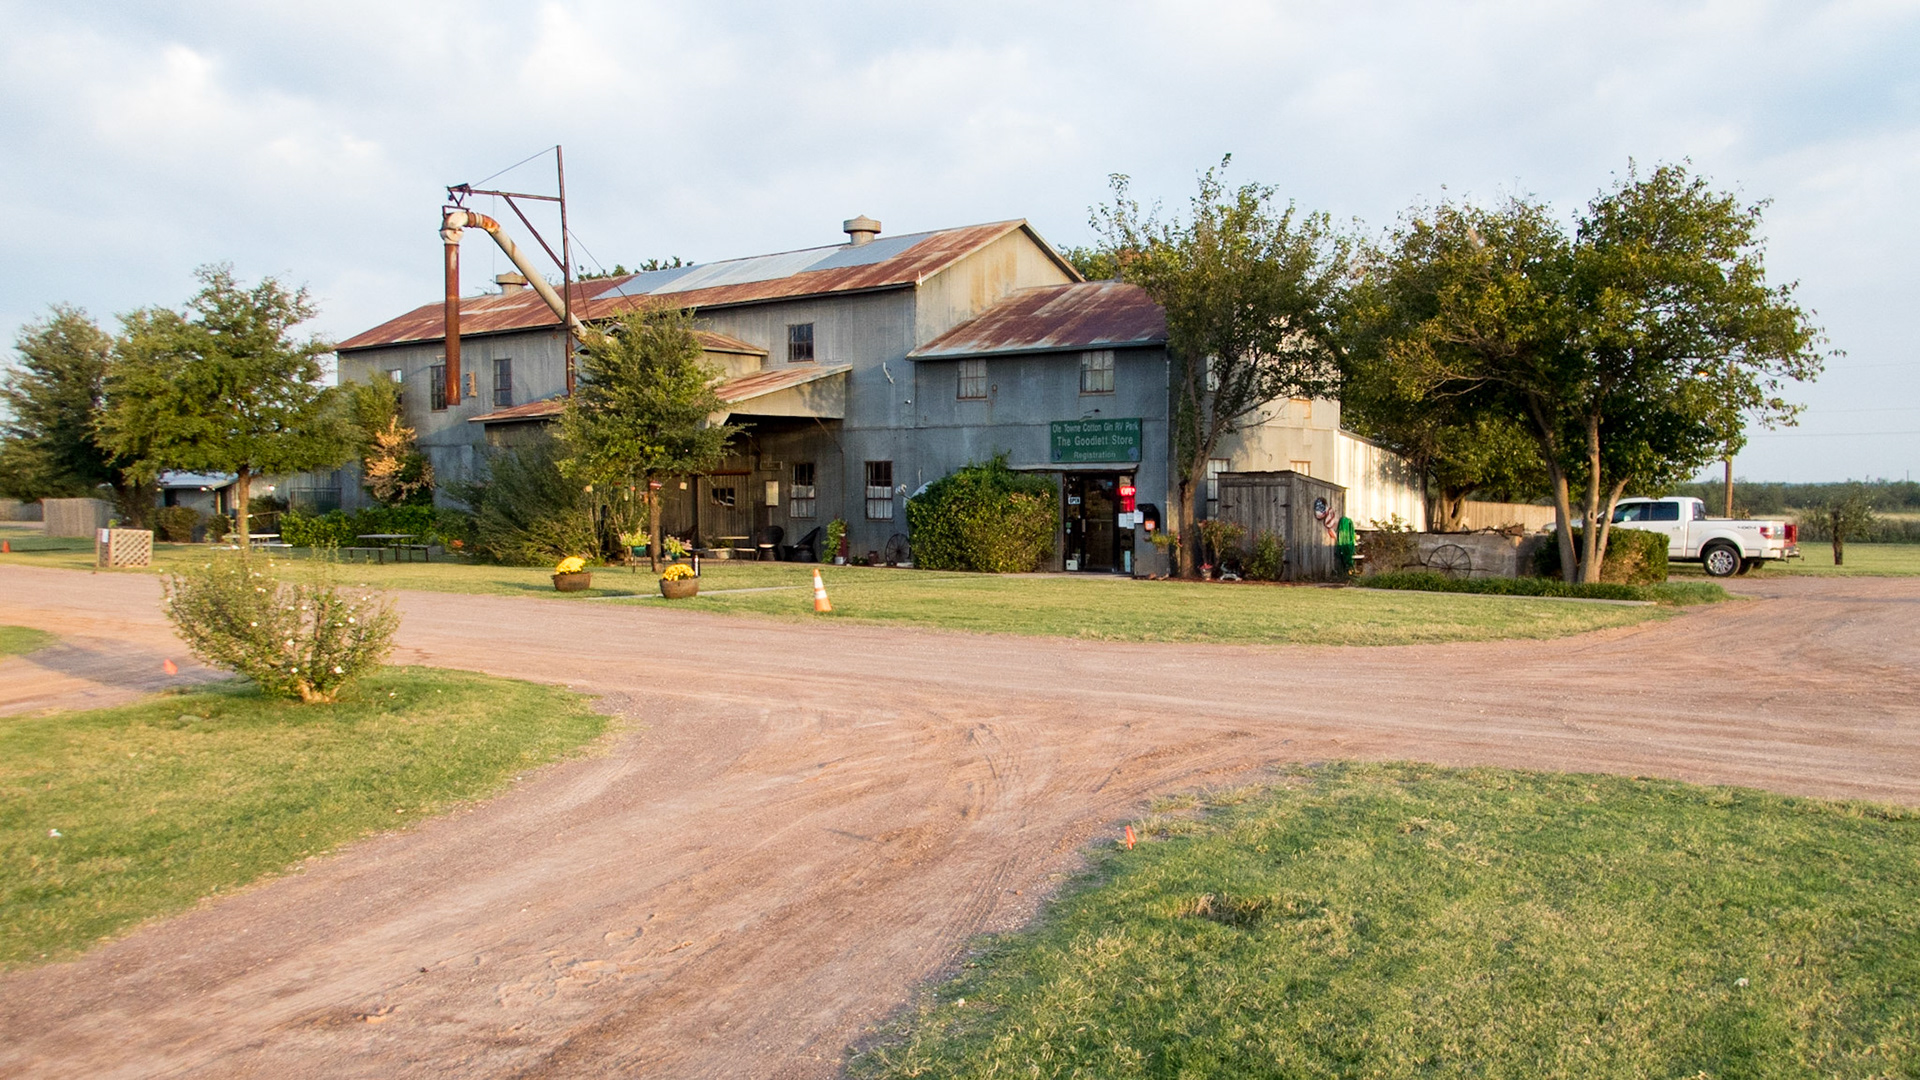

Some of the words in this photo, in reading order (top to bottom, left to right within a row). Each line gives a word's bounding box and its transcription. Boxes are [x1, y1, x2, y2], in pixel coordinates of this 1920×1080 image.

[1082, 422, 1102, 432] Cotton
[1103, 422, 1113, 431] Gin
[1125, 421, 1138, 431] Park
[1057, 436, 1071, 446] The
[1074, 435, 1108, 446] Goodlett
[1111, 434, 1133, 445] Store
[1073, 451, 1116, 460] Registration
